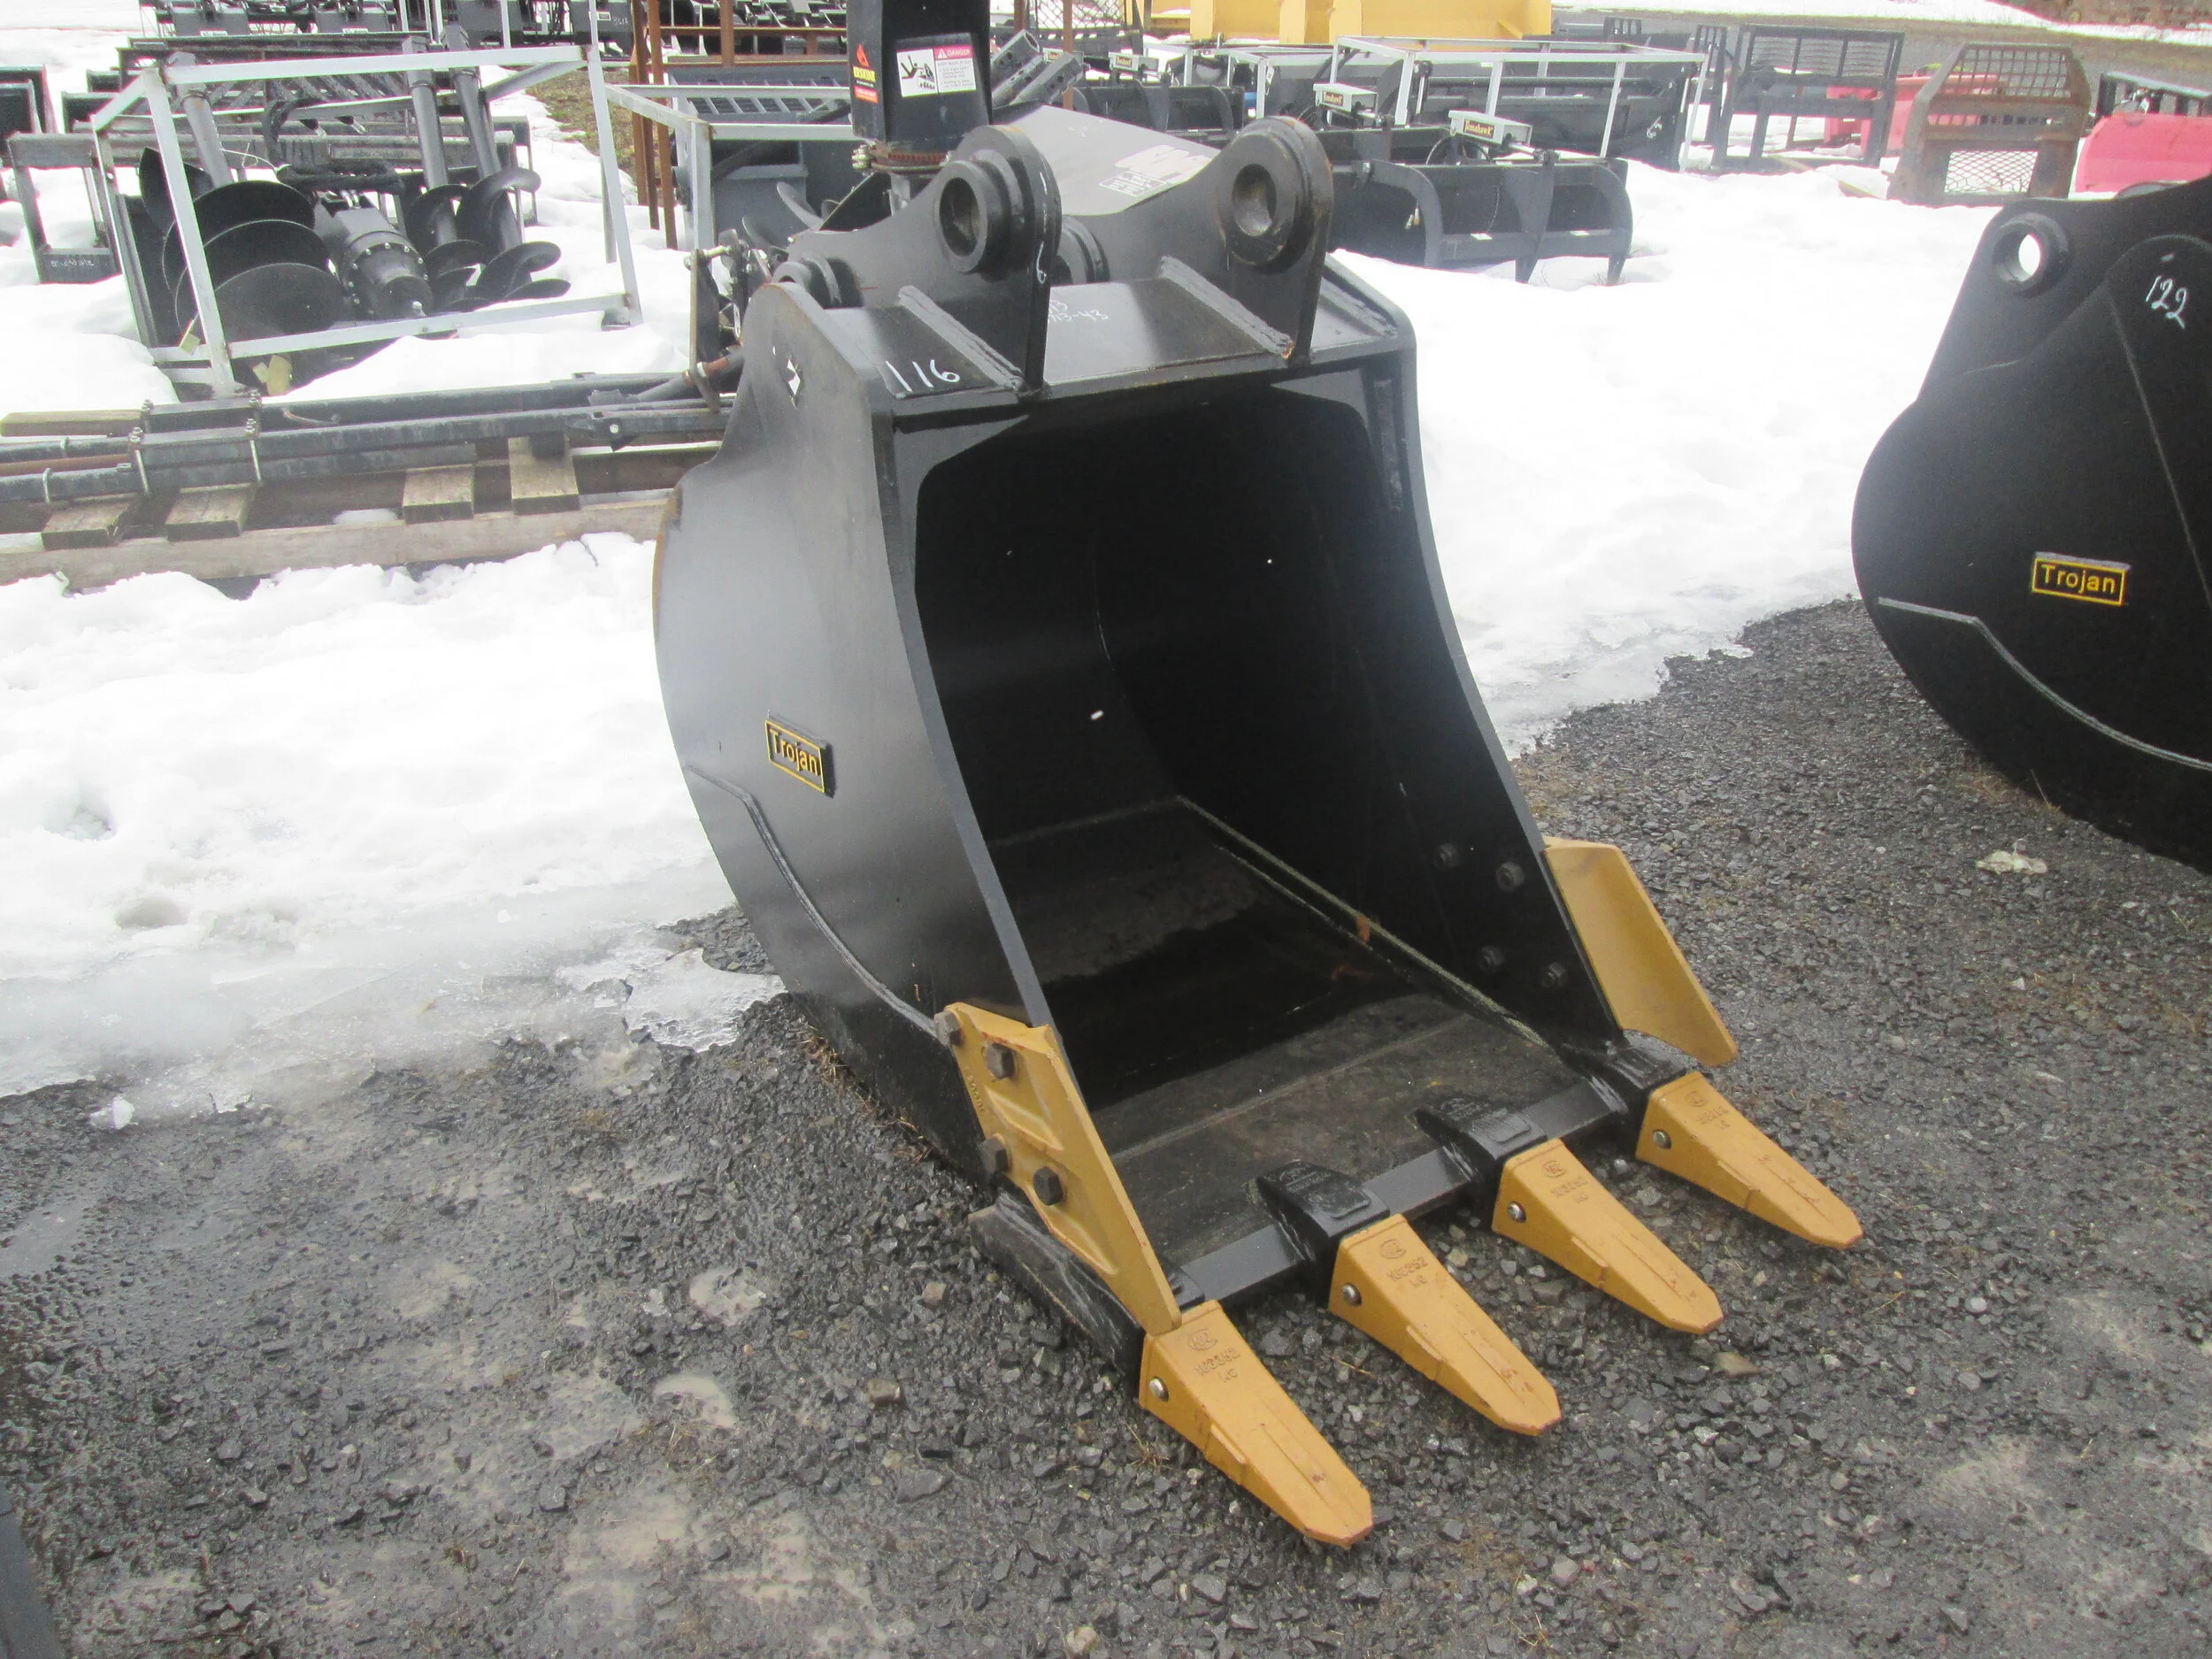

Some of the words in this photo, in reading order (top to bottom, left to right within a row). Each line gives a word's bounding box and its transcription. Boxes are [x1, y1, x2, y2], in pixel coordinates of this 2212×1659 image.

[947, 48, 971, 58] DANGER
[1463, 119, 1494, 136] Tomahawk
[2145, 275, 2188, 330] 122
[885, 359, 961, 392] 116
[2040, 564, 2116, 595] Trojan
[769, 727, 819, 776] Trojan
